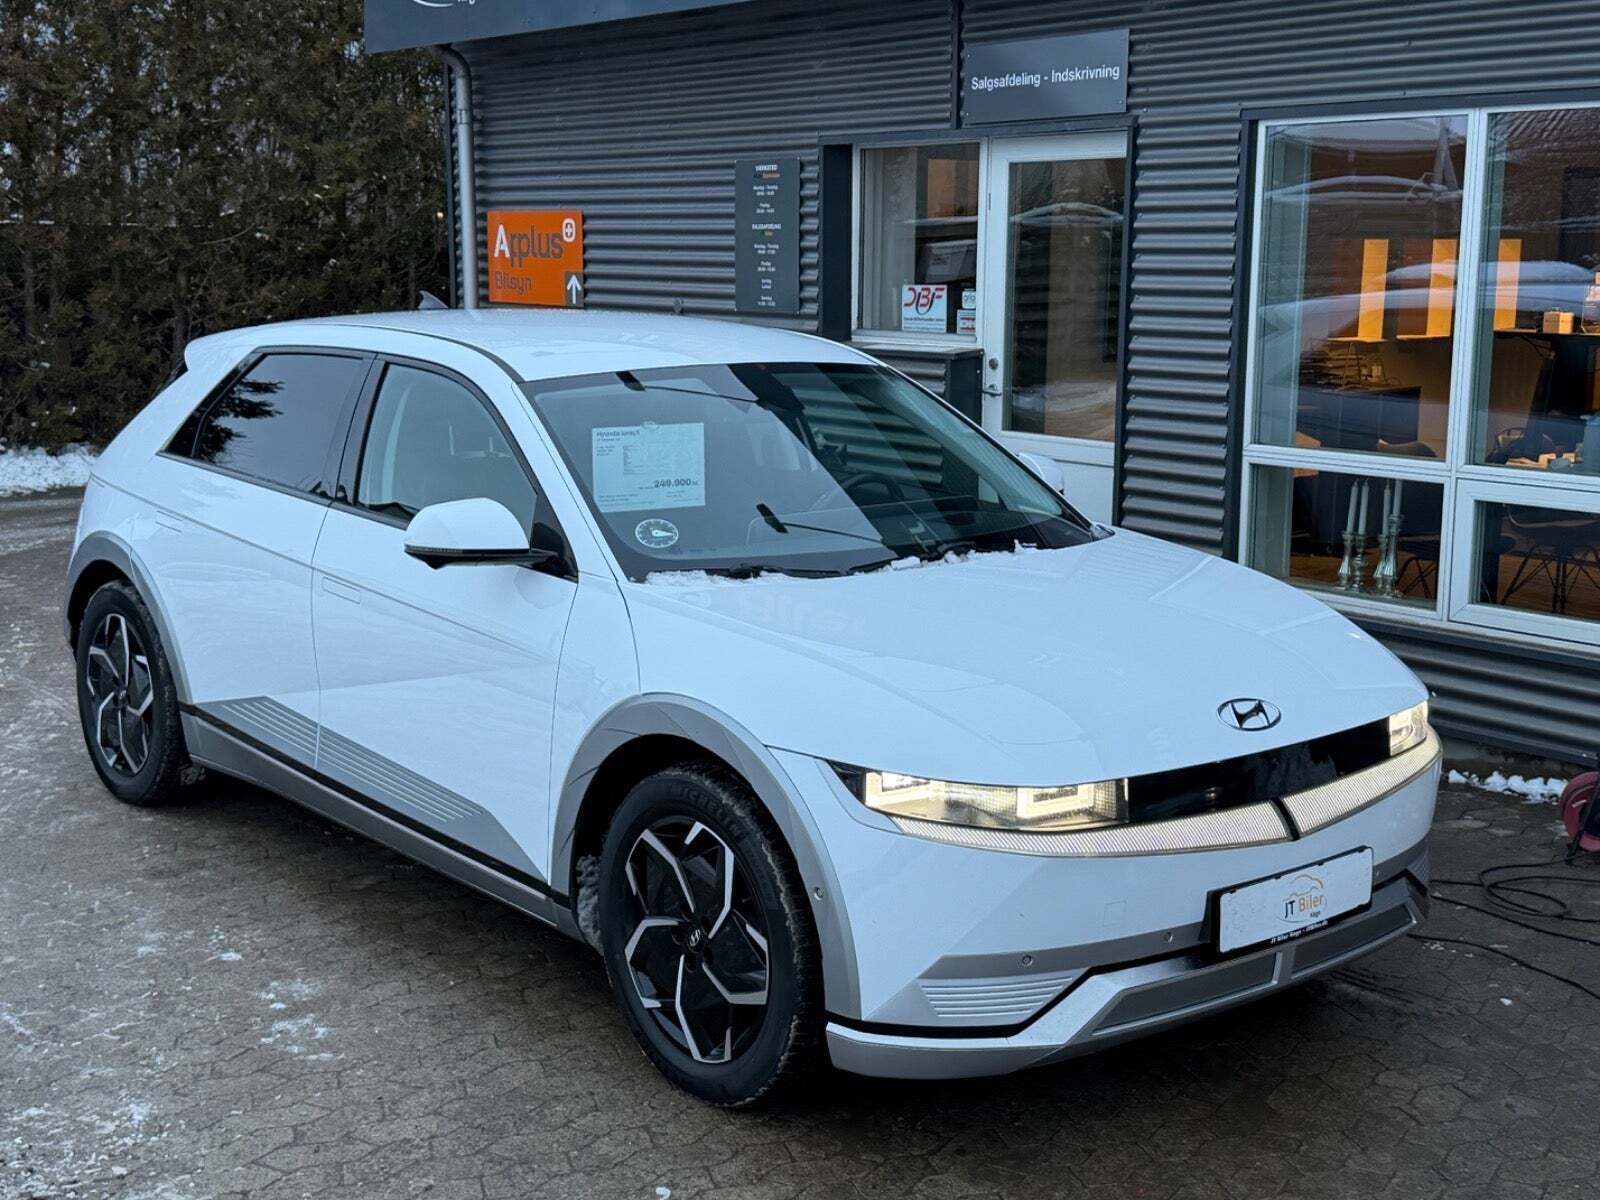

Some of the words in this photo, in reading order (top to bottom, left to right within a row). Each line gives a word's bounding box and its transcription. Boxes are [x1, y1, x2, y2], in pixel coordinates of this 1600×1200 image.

[971, 72, 1041, 92] Salgsafdeling
[1051, 64, 1120, 83] Indskrivning
[495, 271, 532, 296] Bilsyn
[1298, 894, 1324, 913] Biler
